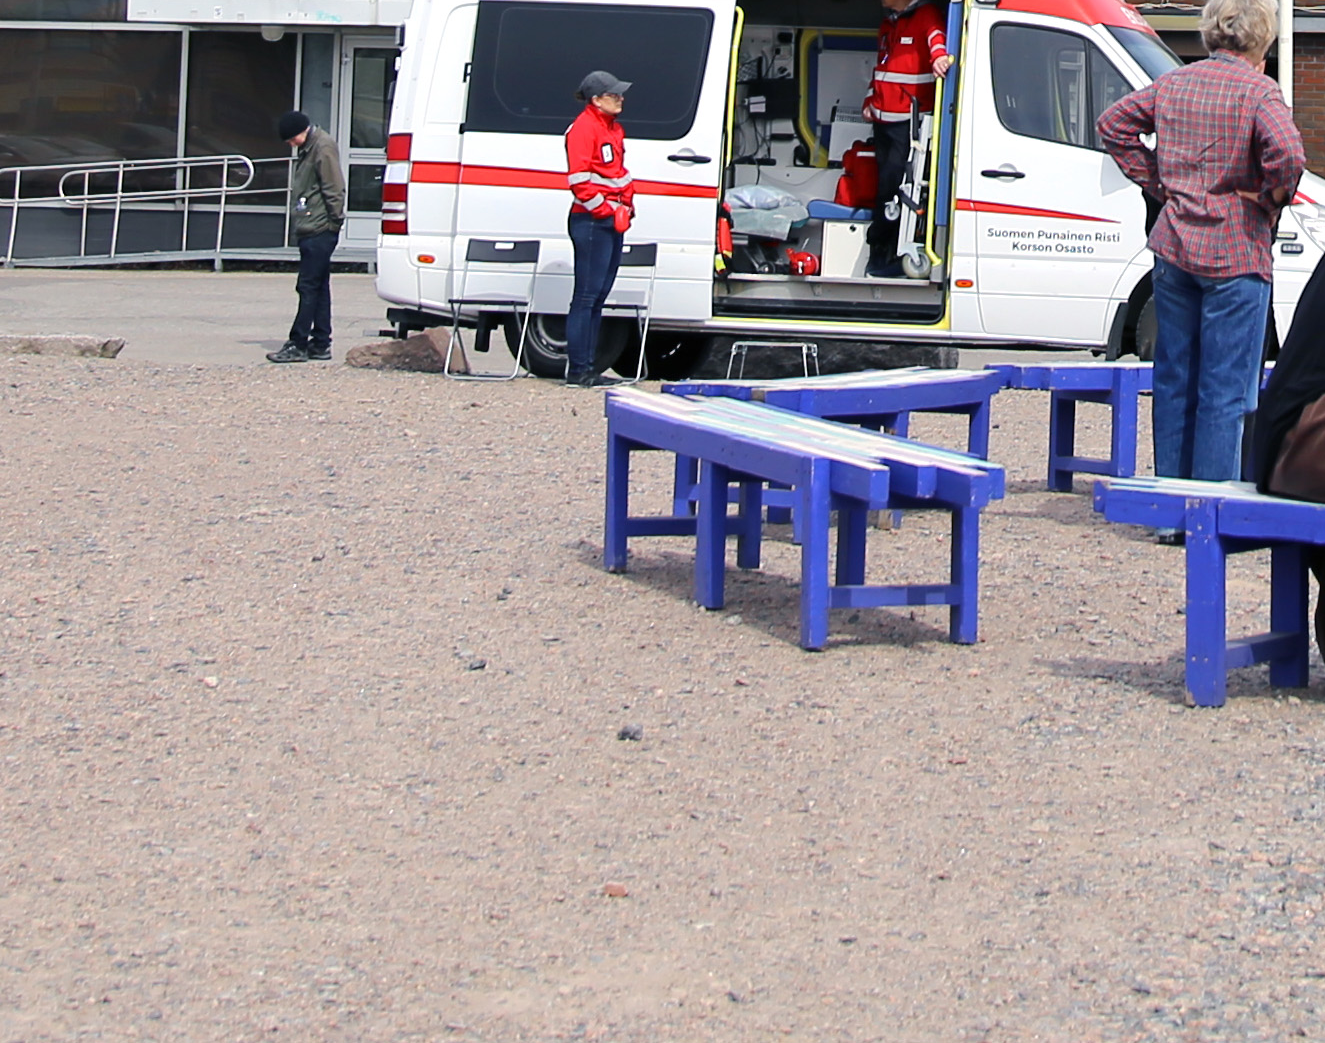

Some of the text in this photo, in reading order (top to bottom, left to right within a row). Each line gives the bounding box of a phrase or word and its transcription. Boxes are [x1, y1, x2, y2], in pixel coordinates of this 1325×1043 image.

[988, 228, 1120, 243] Suomen Punainen Risti
[1012, 241, 1094, 254] Korson Osasto
